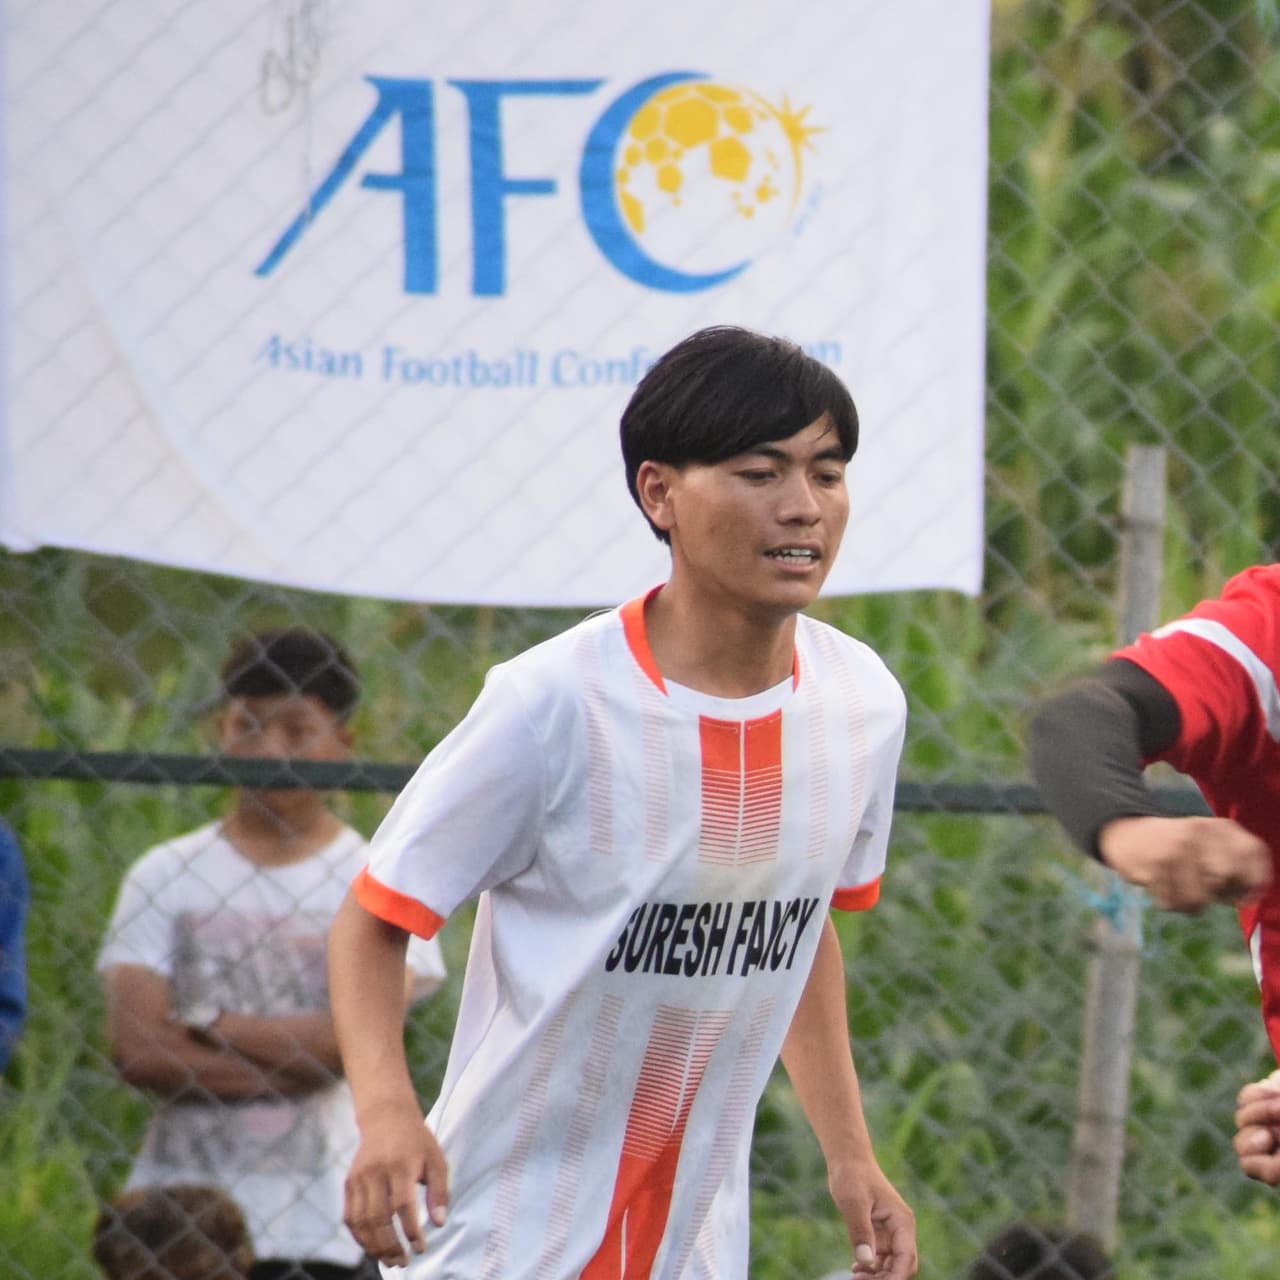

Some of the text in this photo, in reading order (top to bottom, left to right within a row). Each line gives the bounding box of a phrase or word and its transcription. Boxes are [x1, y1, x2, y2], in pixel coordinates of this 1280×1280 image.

[253, 70, 752, 299] AFC
[254, 332, 366, 379] Asian
[380, 343, 540, 389] Football
[605, 901, 733, 978] SURESH
